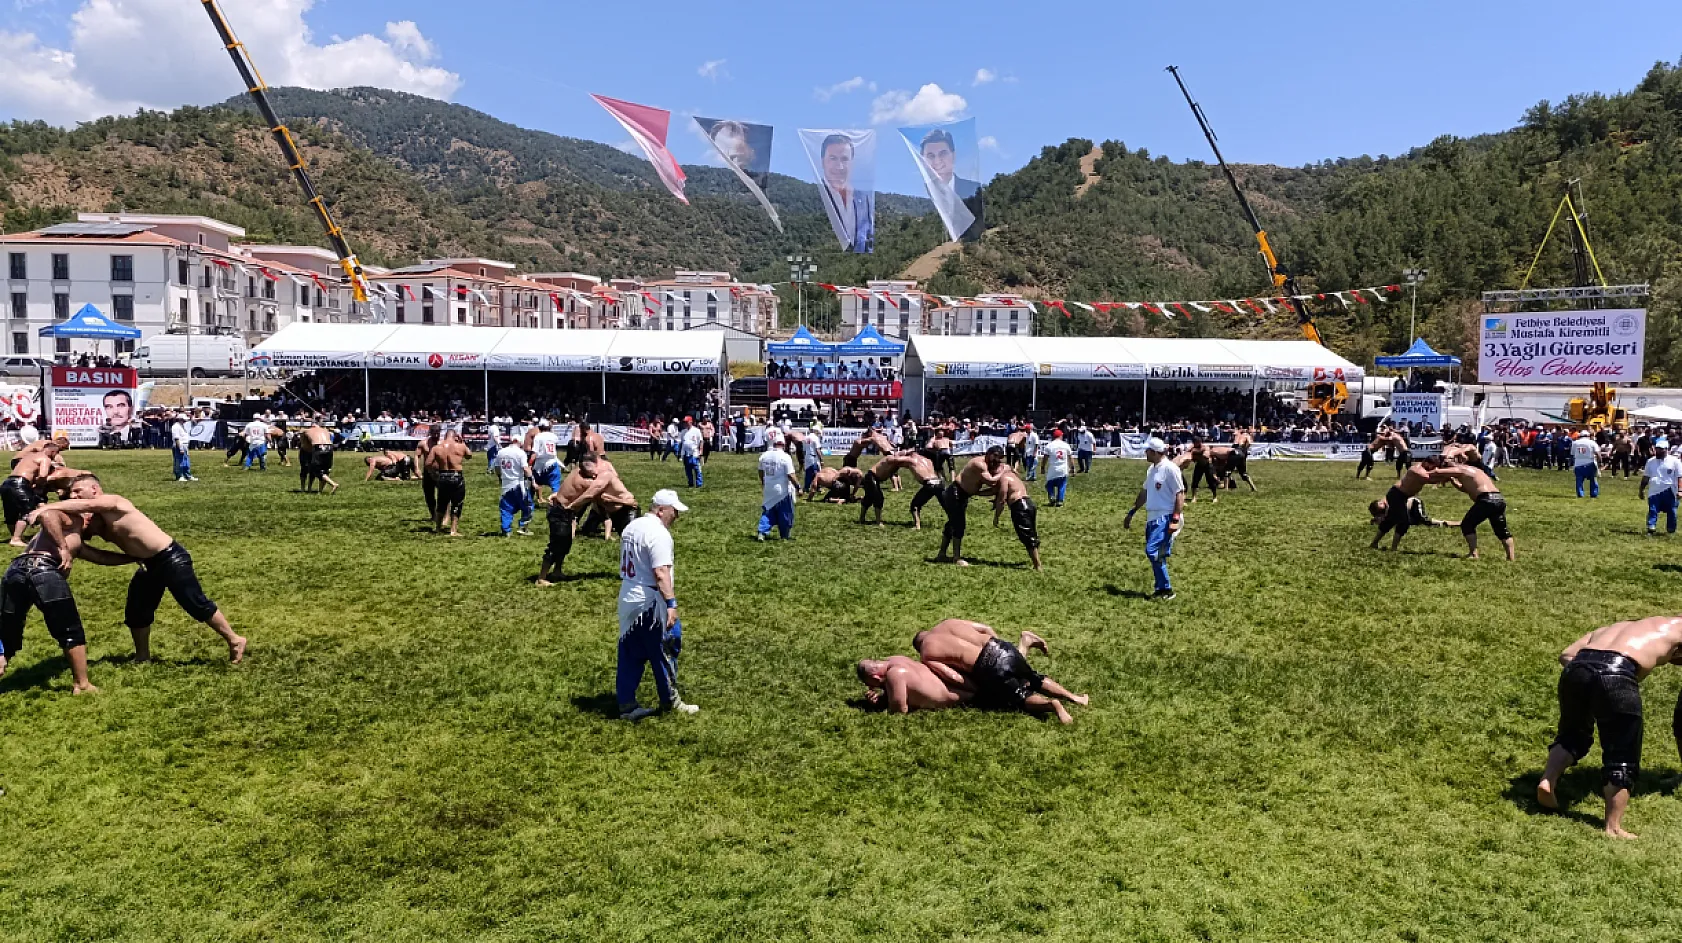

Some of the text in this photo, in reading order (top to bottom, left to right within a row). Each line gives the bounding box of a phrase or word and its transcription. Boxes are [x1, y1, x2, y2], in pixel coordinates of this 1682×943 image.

[1515, 318, 1551, 330] Fethiye
[1553, 316, 1606, 328] Belediyesi
[1511, 328, 1555, 339] Mustafa
[1559, 326, 1610, 338] Kiremitli
[662, 361, 691, 372] LOV
[1494, 357, 1624, 377] Hoş Geldiniz
[65, 371, 124, 385] BASIN
[779, 383, 835, 396] HAKEM
[55, 407, 103, 416] MUSTAFA
